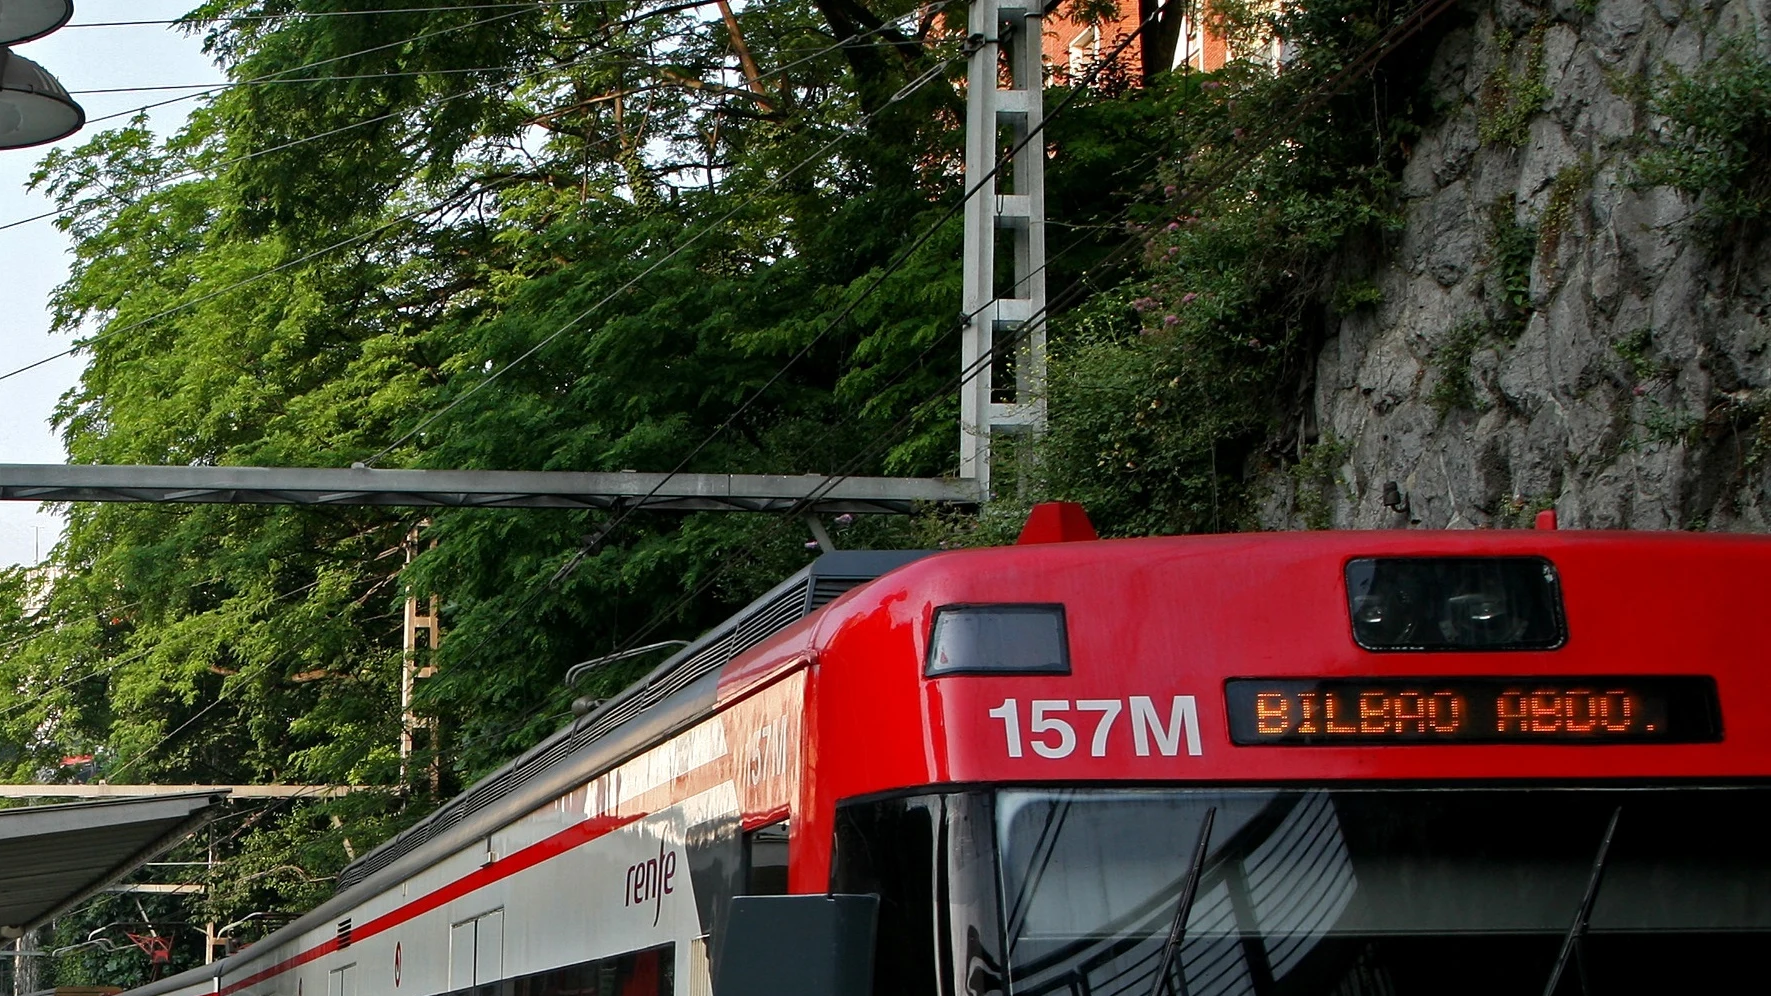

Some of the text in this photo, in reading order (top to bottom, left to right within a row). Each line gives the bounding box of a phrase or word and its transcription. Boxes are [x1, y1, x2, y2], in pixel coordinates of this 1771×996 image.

[989, 695, 1203, 759] 157M
[1257, 691, 1655, 733] BILBAO ABDO.
[625, 823, 676, 927] renfe
